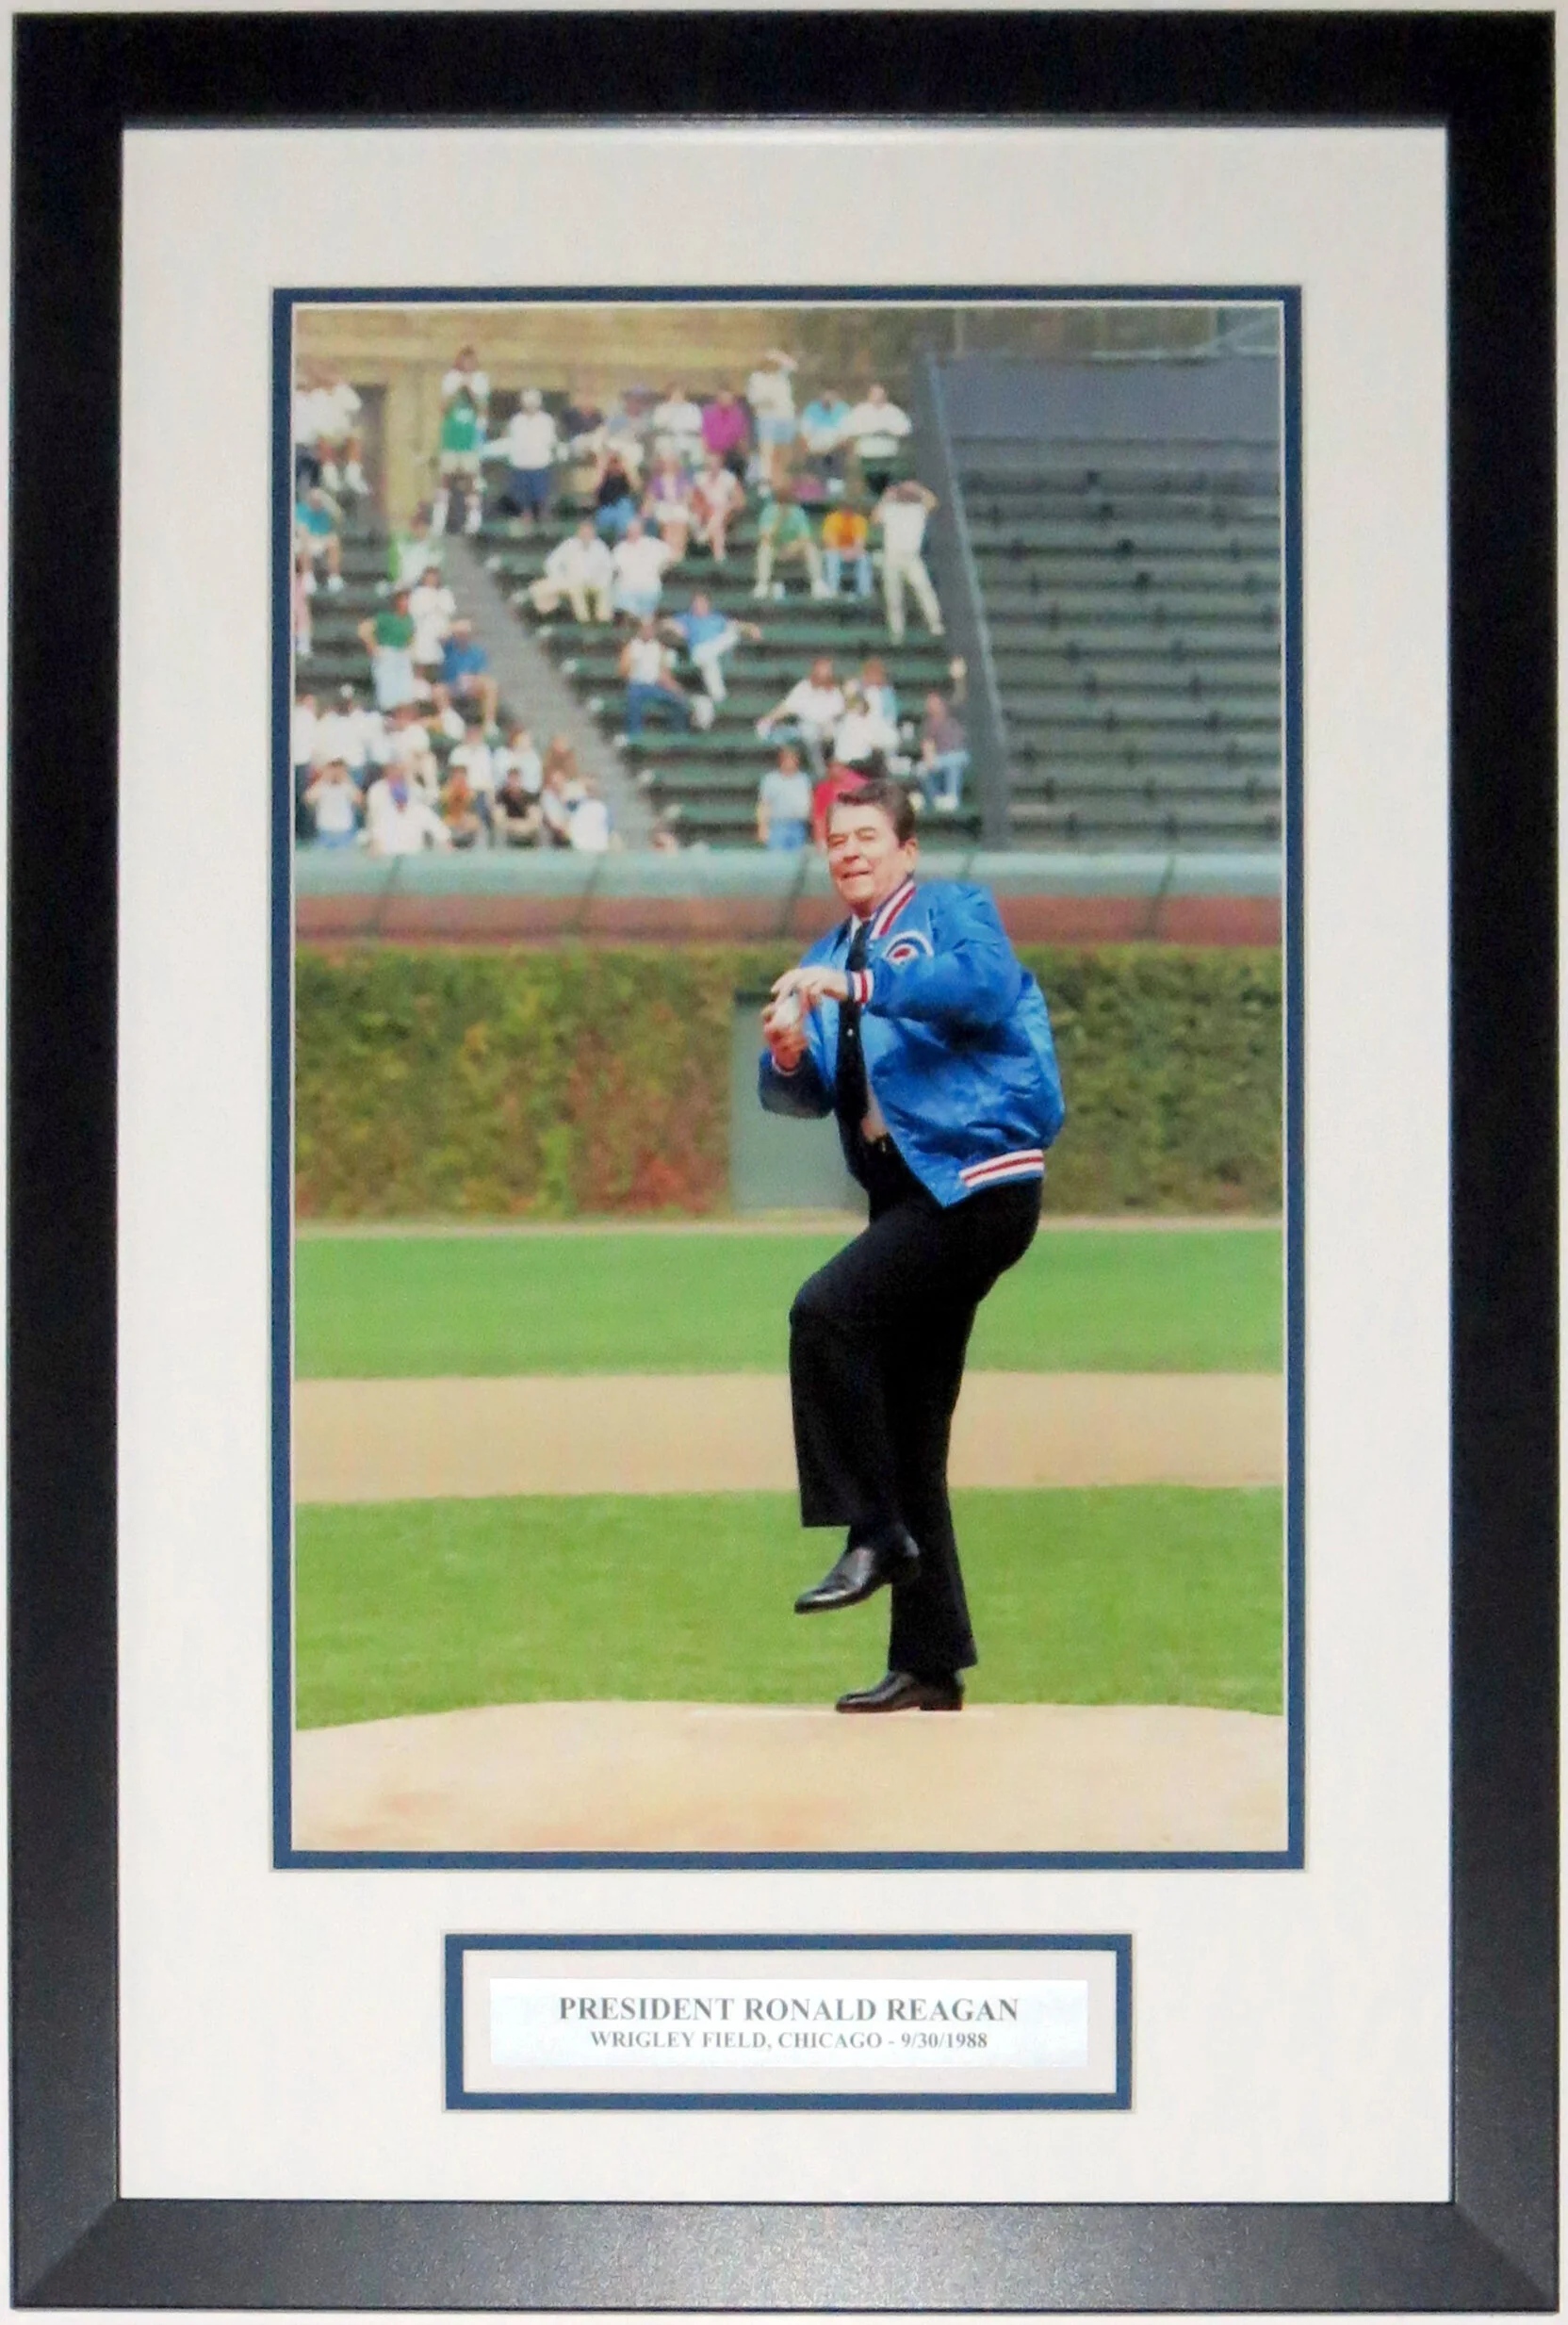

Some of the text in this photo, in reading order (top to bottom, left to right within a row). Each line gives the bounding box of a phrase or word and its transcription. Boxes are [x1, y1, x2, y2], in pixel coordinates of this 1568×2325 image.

[559, 1997, 1019, 2022] PRESIDENT RONALD REAGAN
[591, 2031, 695, 2049] WRIGLEY
[702, 2032, 773, 2052] FIELD,
[777, 2032, 883, 2049] CHICAGO
[901, 2033, 988, 2049] 9/30/1988
